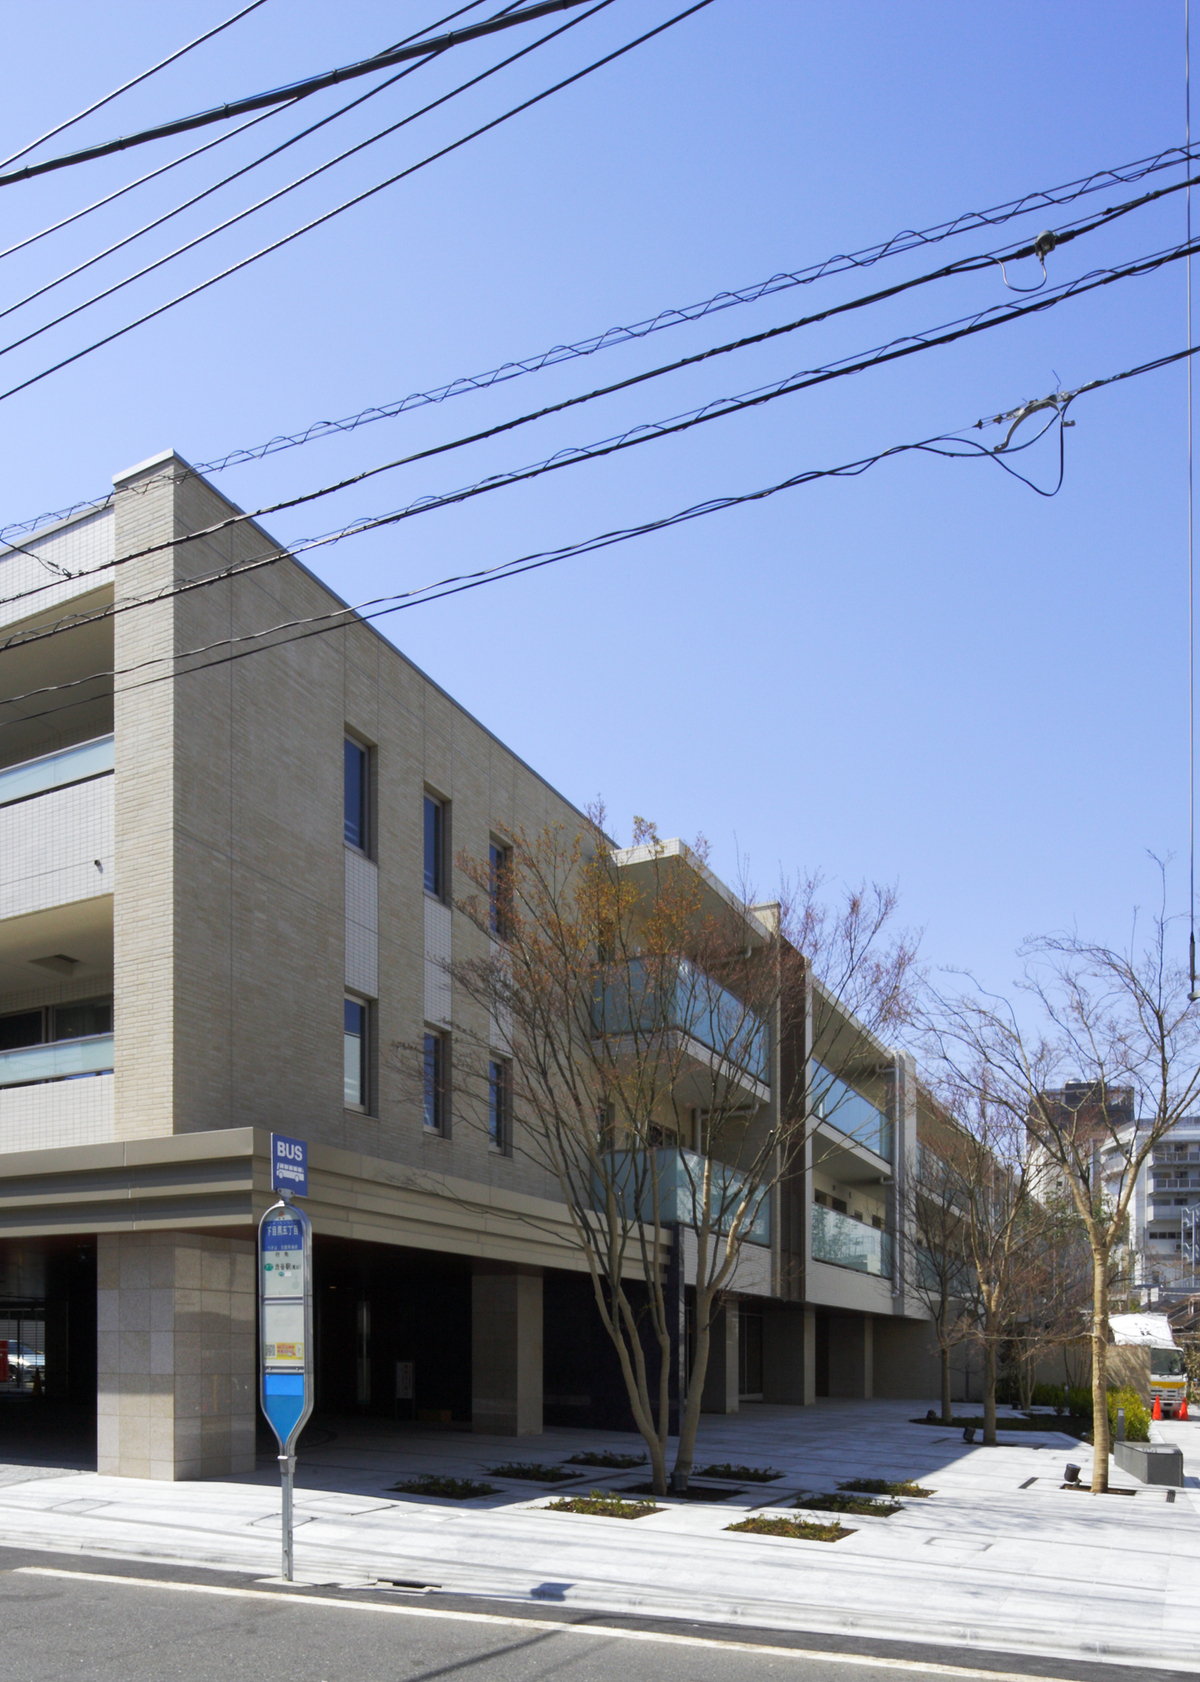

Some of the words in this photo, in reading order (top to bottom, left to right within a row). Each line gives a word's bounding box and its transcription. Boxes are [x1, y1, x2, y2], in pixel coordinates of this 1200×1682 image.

[277, 1141, 303, 1161] BUS
[266, 1225, 299, 1236] 下目黒五丁目
